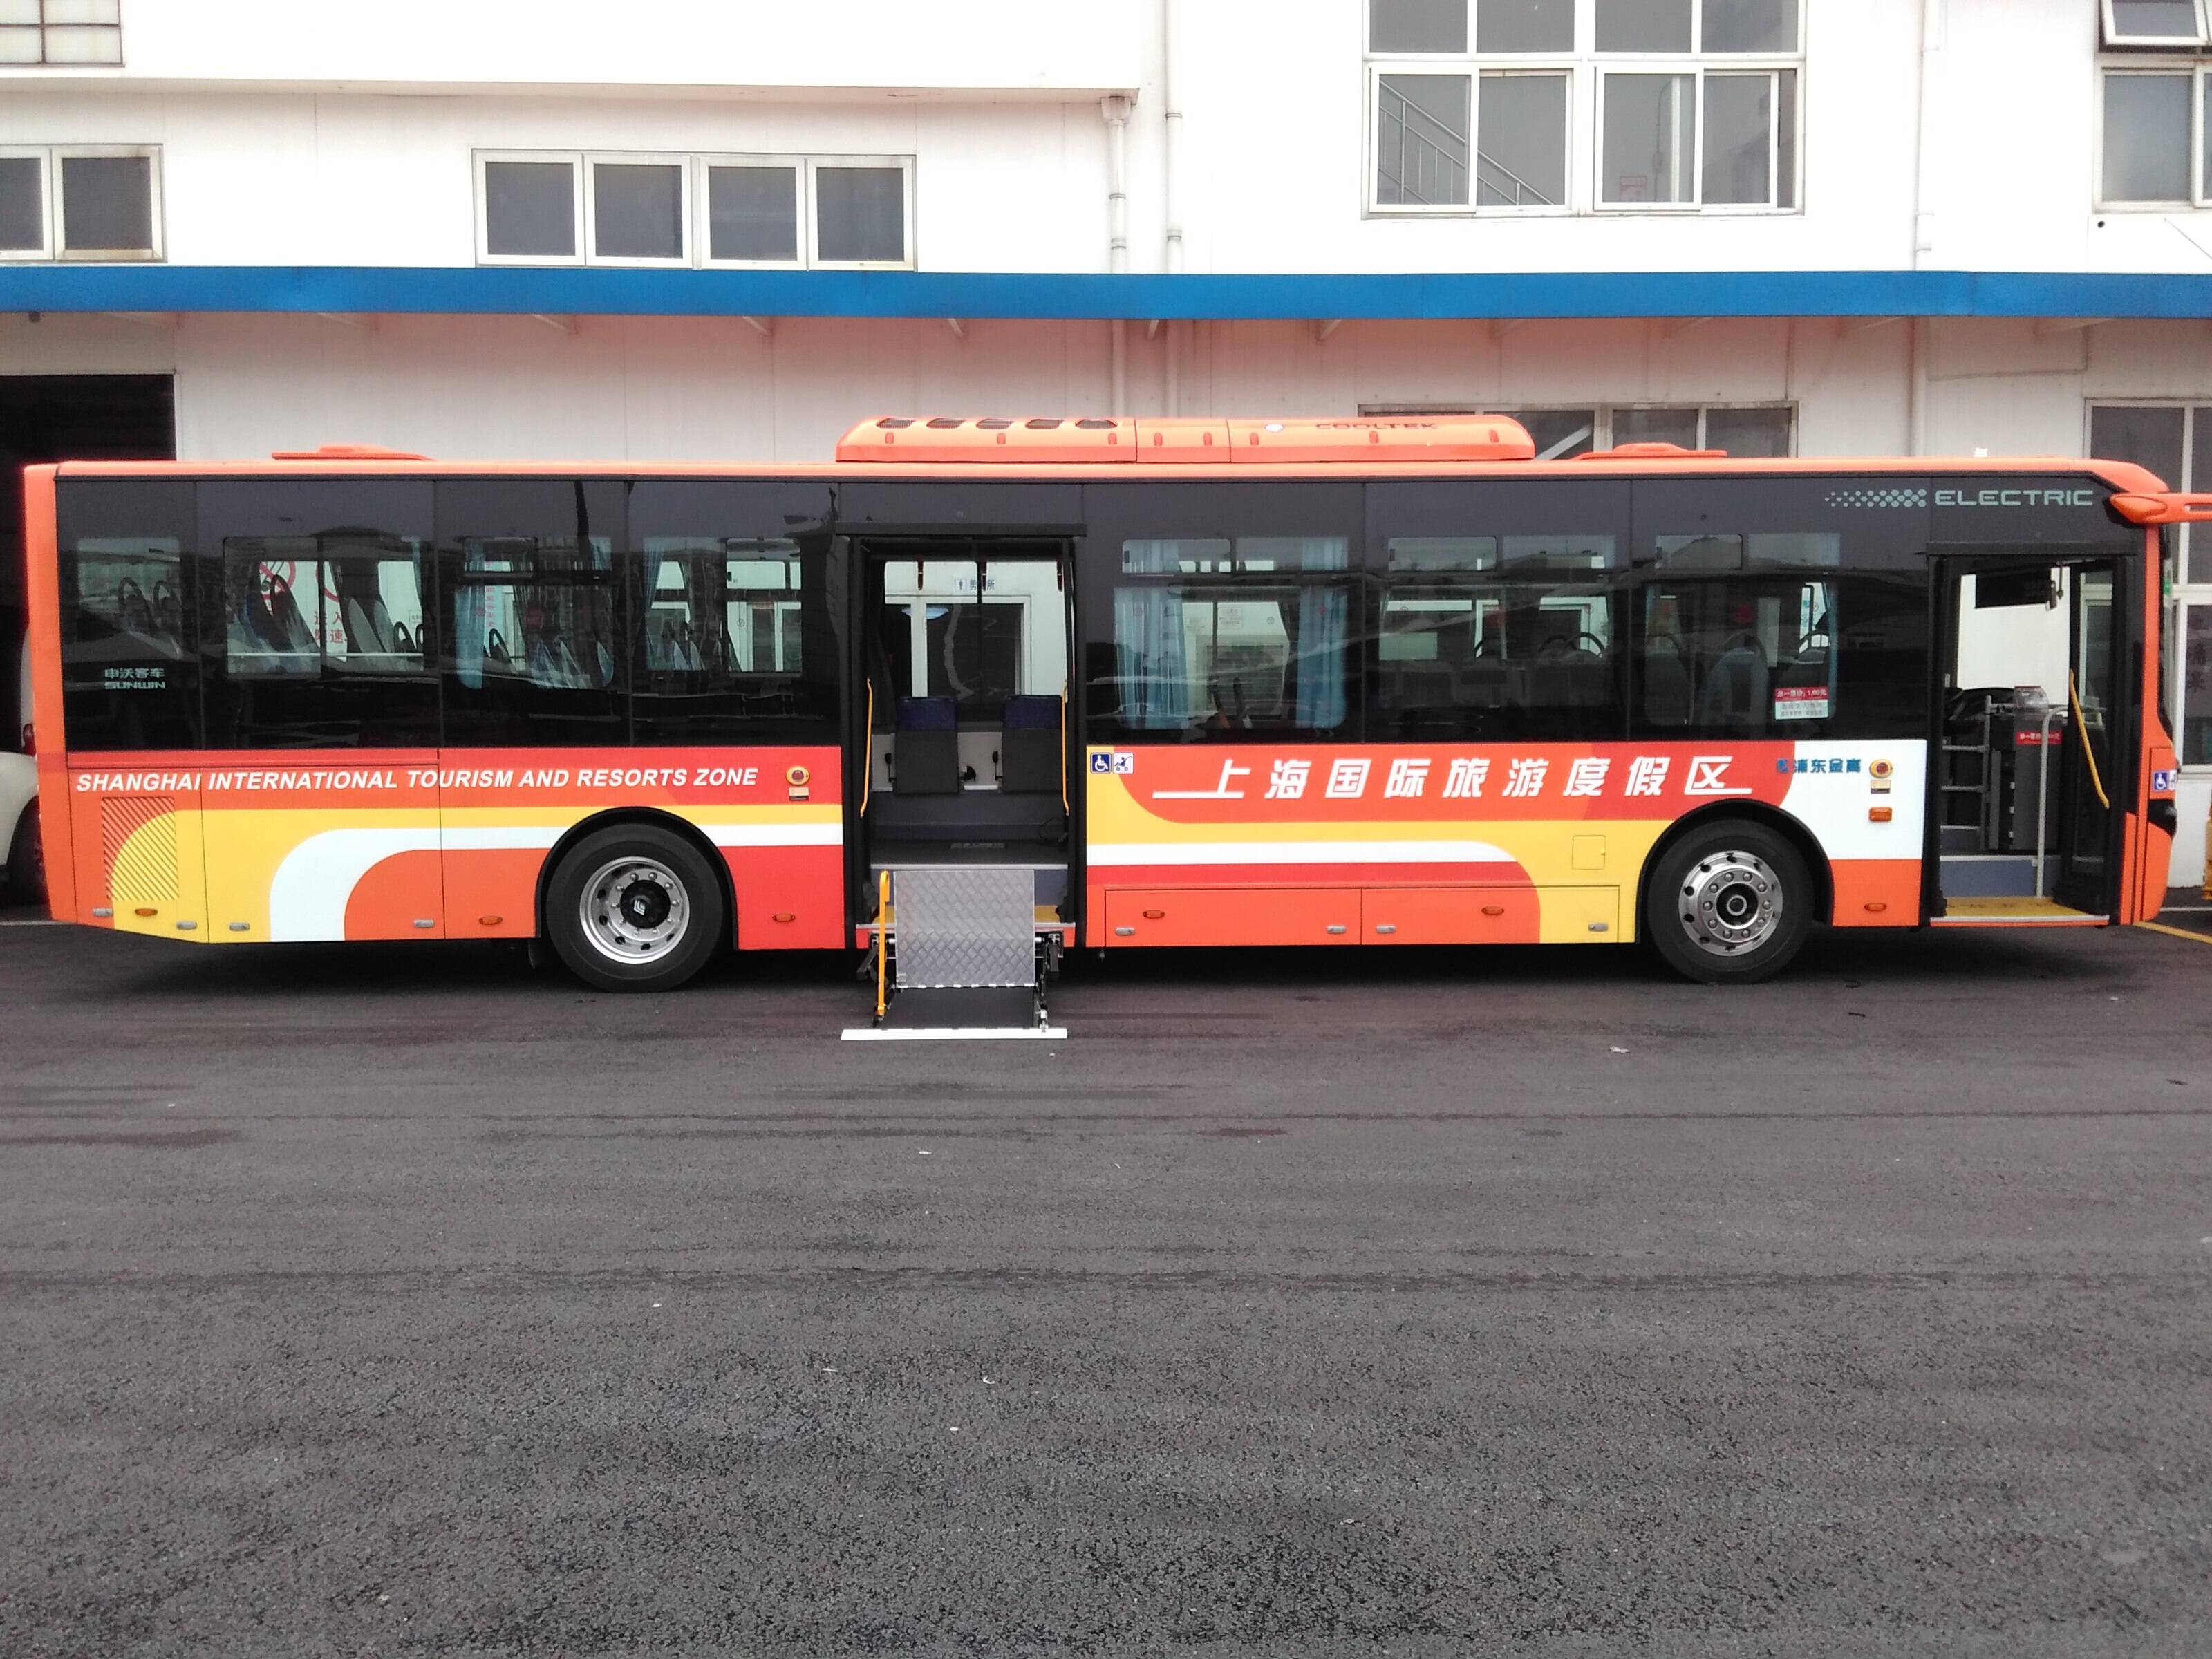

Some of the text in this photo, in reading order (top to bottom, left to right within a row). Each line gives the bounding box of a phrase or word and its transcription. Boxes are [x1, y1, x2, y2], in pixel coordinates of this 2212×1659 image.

[1934, 489, 2094, 507] ELECTRIC
[969, 579, 995, 592] 男所
[104, 667, 165, 679] 申沃客车
[104, 681, 166, 690] SUNWIN
[1792, 758, 1862, 774] 浦东金高
[77, 767, 759, 792] SHANGHAI INTERNATIONAL TOURISM AND RESORTS ZONE
[1152, 756, 1753, 800] 上海国际旅游度假区
